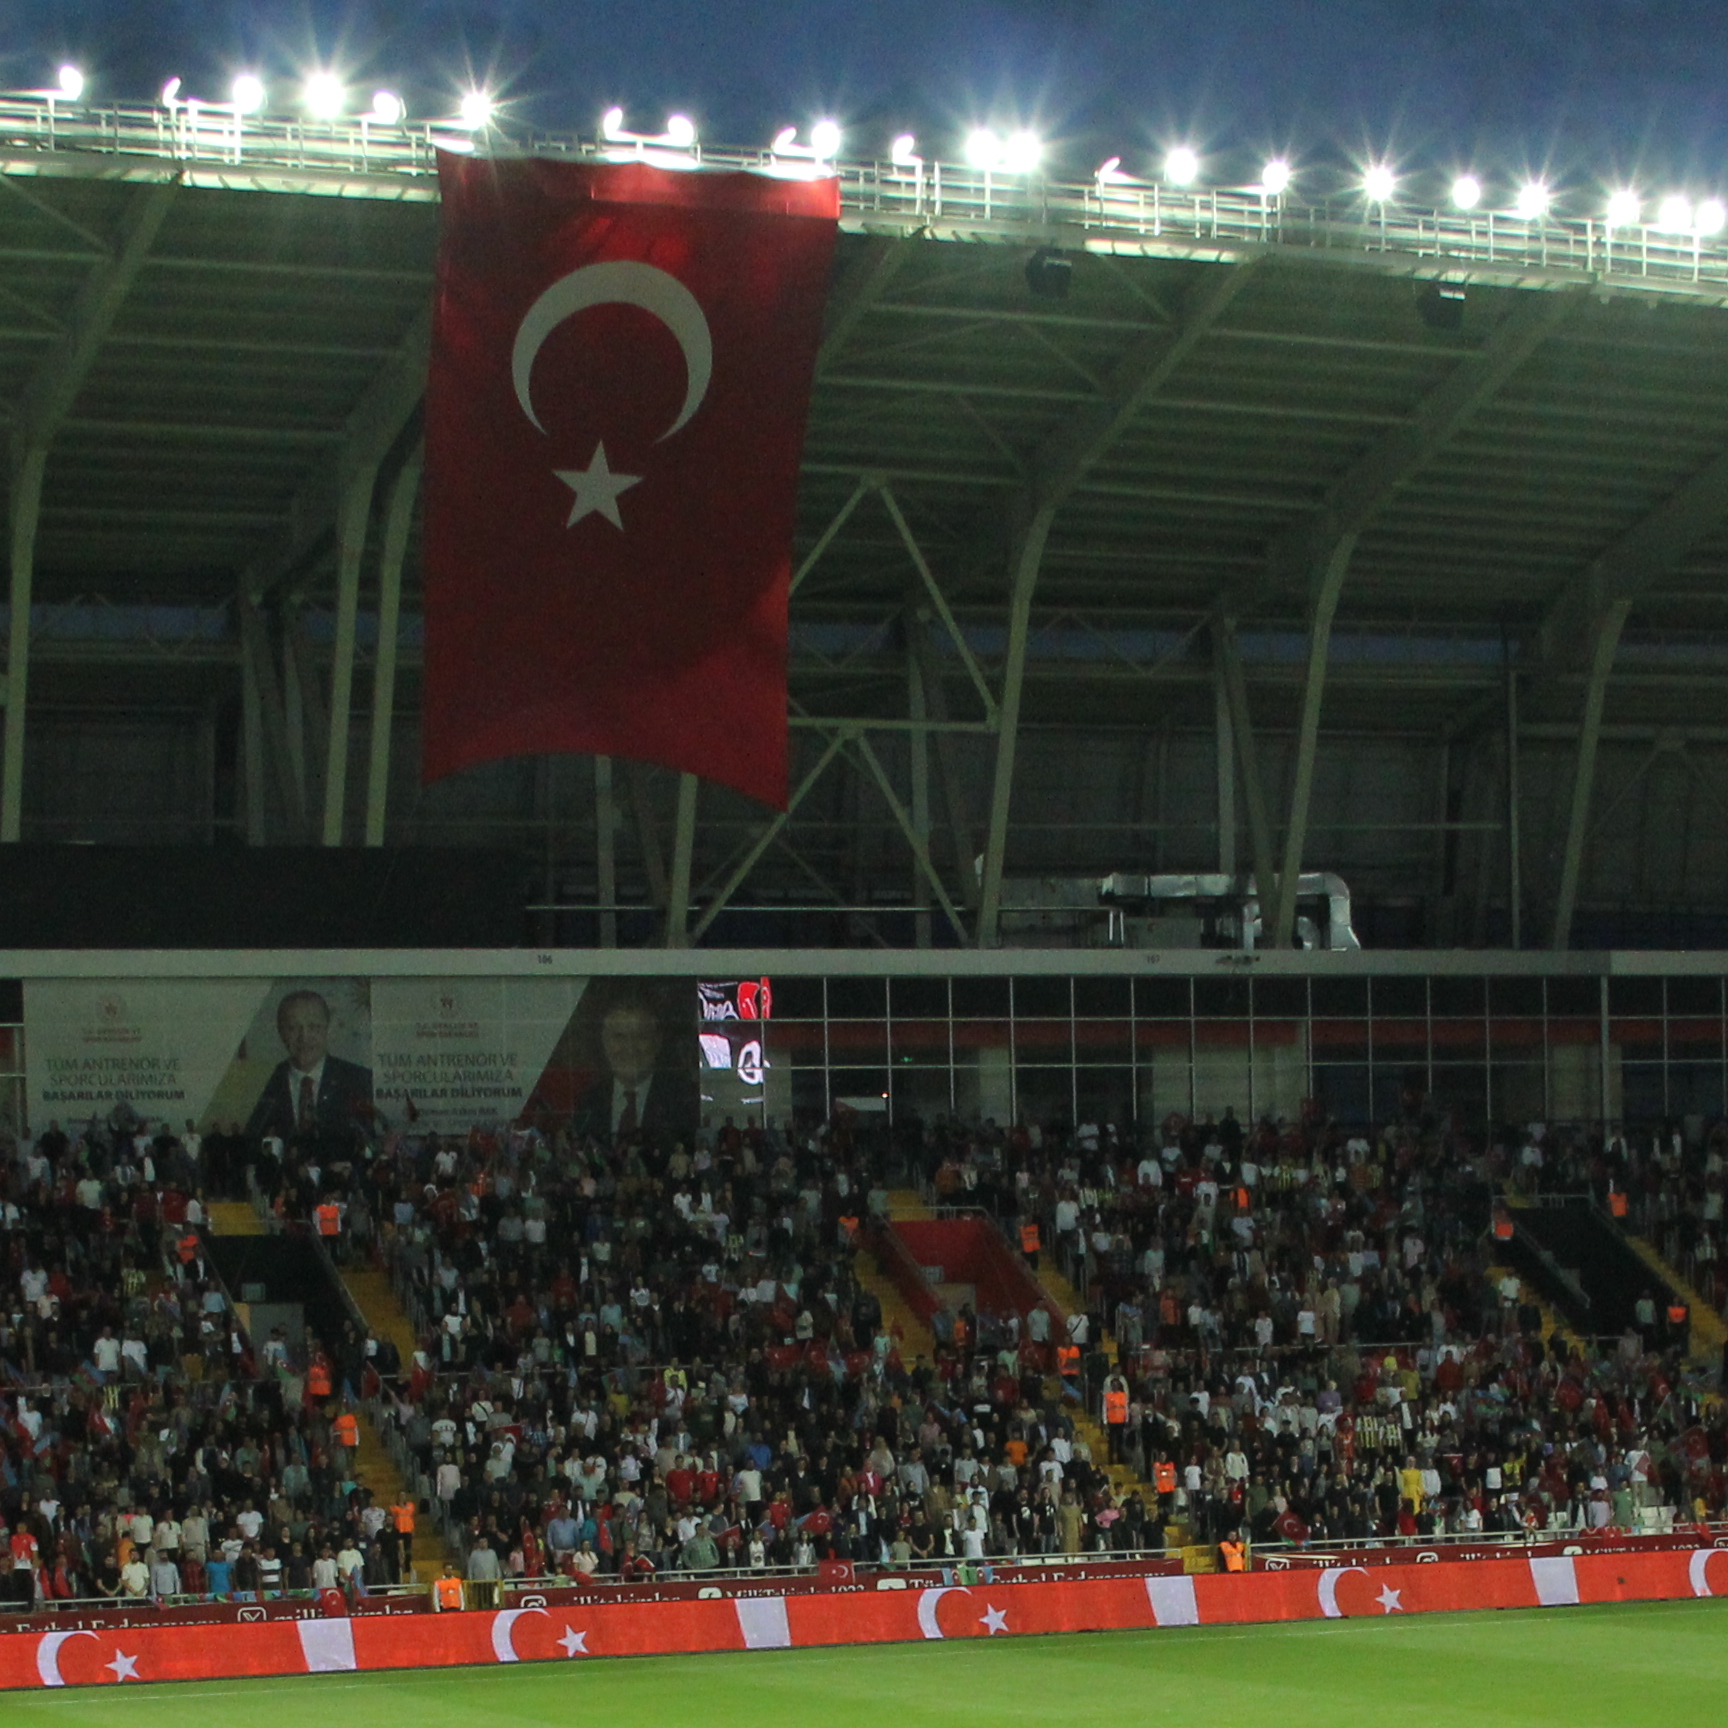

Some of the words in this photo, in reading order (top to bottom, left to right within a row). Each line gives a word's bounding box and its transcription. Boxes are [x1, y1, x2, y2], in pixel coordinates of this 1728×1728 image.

[164, 1057, 180, 1071] VE
[377, 1053, 413, 1067] TÜM
[416, 1052, 498, 1067] ANTRENÖR
[501, 1053, 518, 1067] VE
